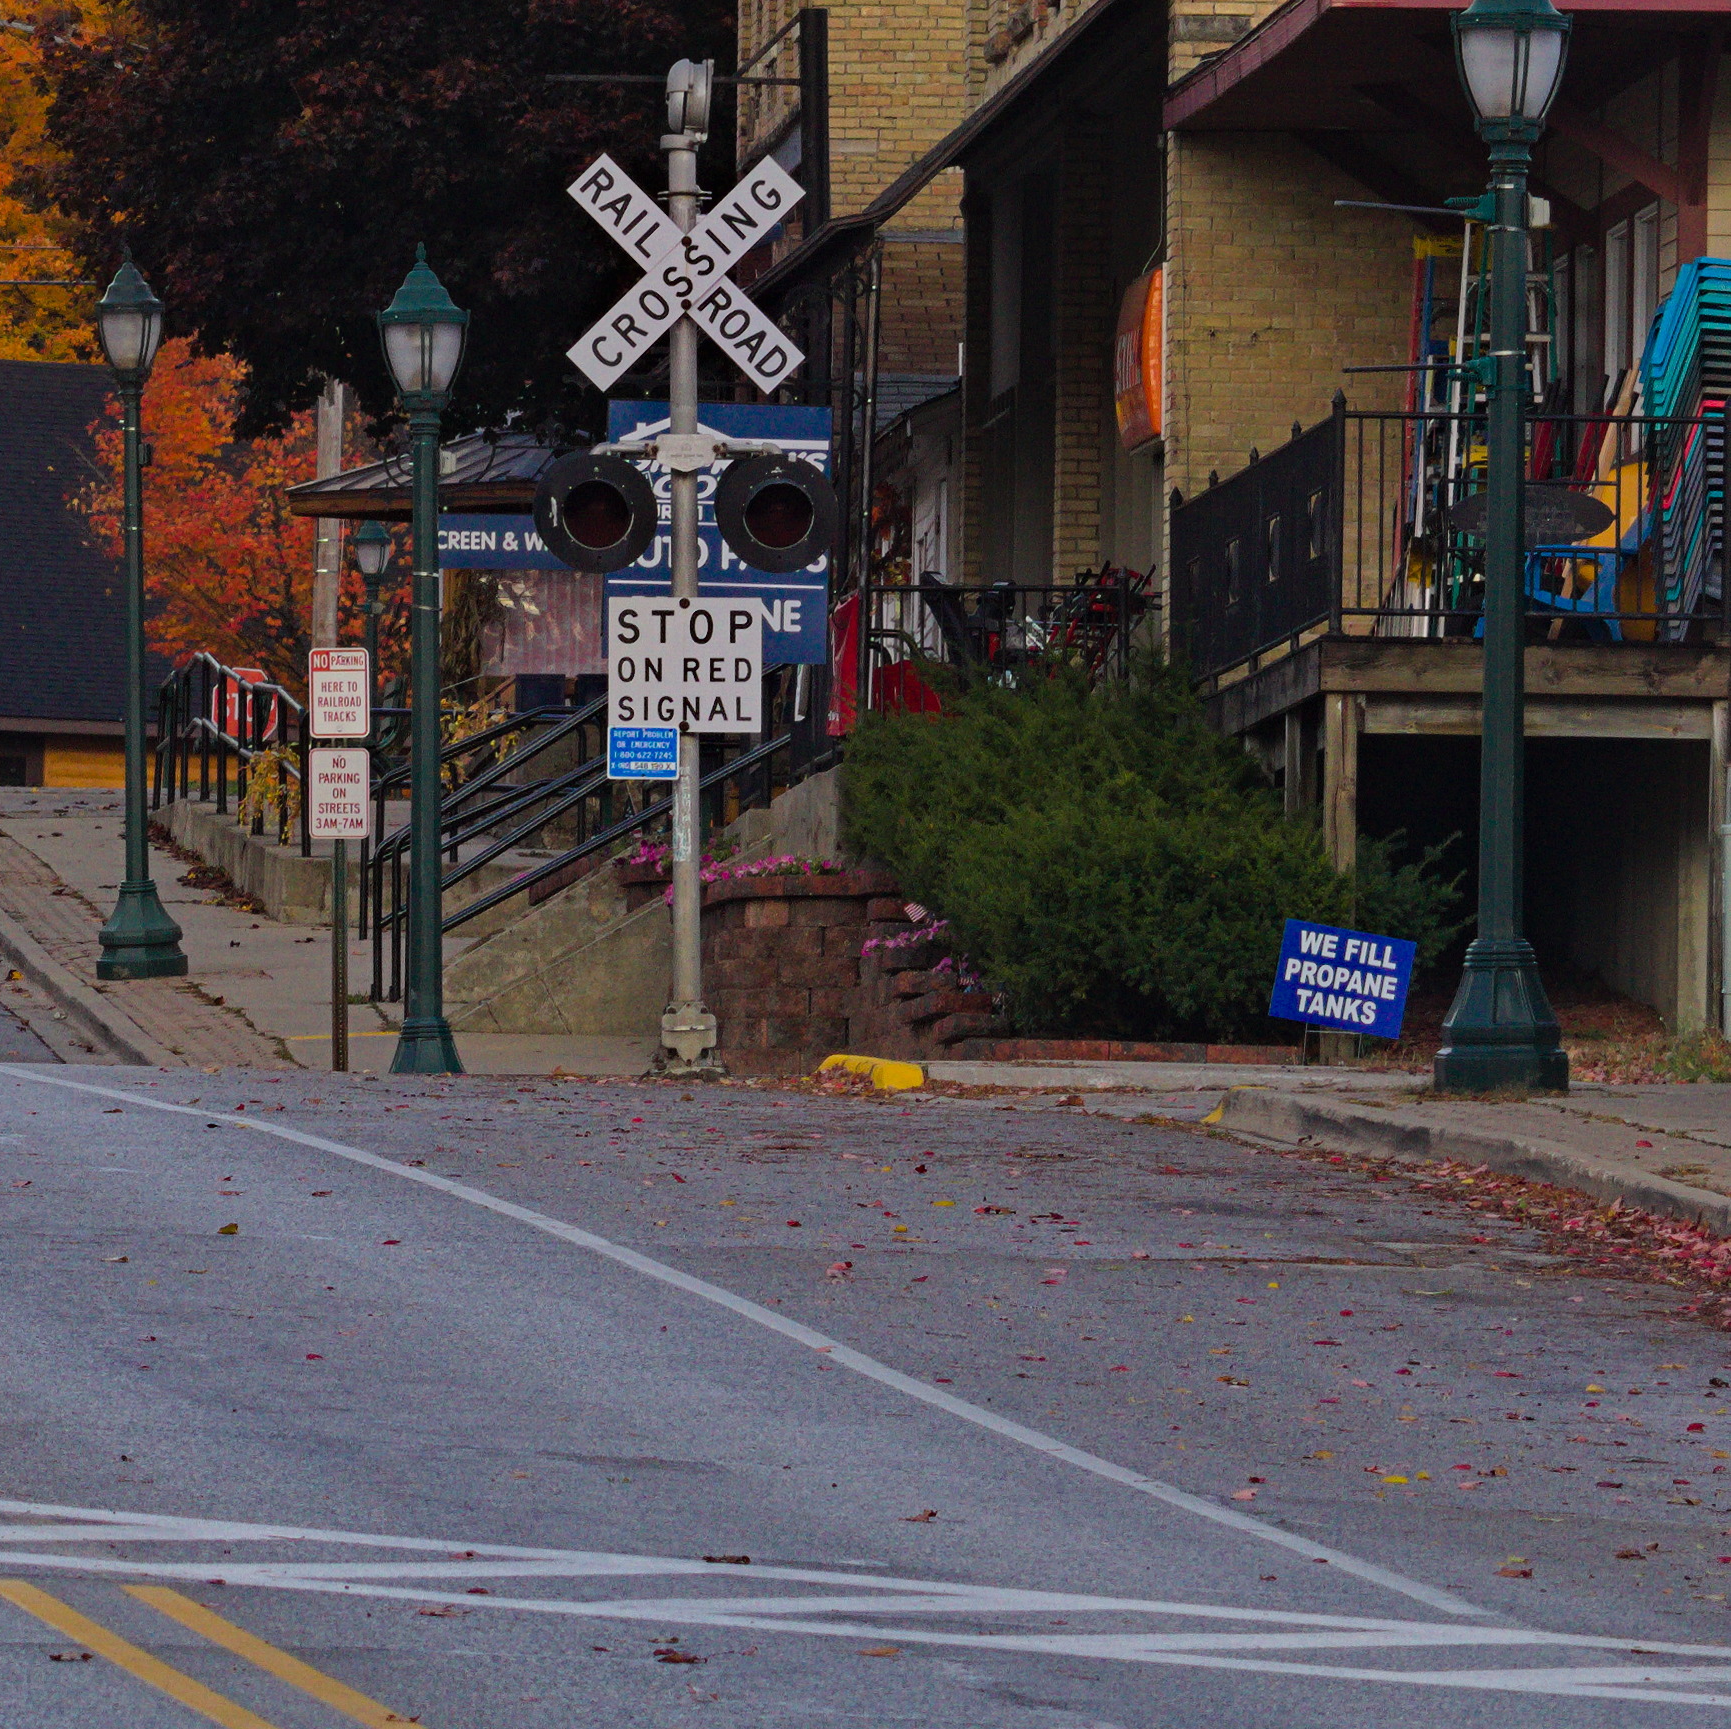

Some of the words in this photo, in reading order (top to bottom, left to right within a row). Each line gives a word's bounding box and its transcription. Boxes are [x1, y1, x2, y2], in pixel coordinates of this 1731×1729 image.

[579, 167, 662, 259] RAIL
[697, 286, 789, 379] ROAD
[590, 179, 782, 368] CROSSING
[438, 530, 496, 551] CREEN
[502, 531, 519, 552] &
[617, 609, 753, 644] STOP
[313, 653, 328, 669] NO
[330, 655, 364, 666] PARKING
[617, 657, 663, 683] ON
[683, 657, 753, 683] RED
[321, 681, 344, 693] HERE
[347, 681, 358, 693] TO
[317, 696, 362, 708] RAILROAD
[617, 695, 753, 722] SIGNAL
[323, 711, 357, 722] TRACKS
[613, 730, 640, 739] REPORT
[642, 730, 674, 739] PROBLEM
[616, 740, 627, 748] OR
[630, 740, 671, 749] EMERGENCY
[332, 757, 347, 769] NO
[318, 772, 361, 785] PARKING
[332, 787, 347, 799] ON
[318, 802, 361, 814] STREETS
[1300, 930, 1339, 959] WE
[1344, 938, 1397, 970] FILL
[1284, 957, 1398, 1001] PROPANE
[1296, 988, 1377, 1025] TANKS
